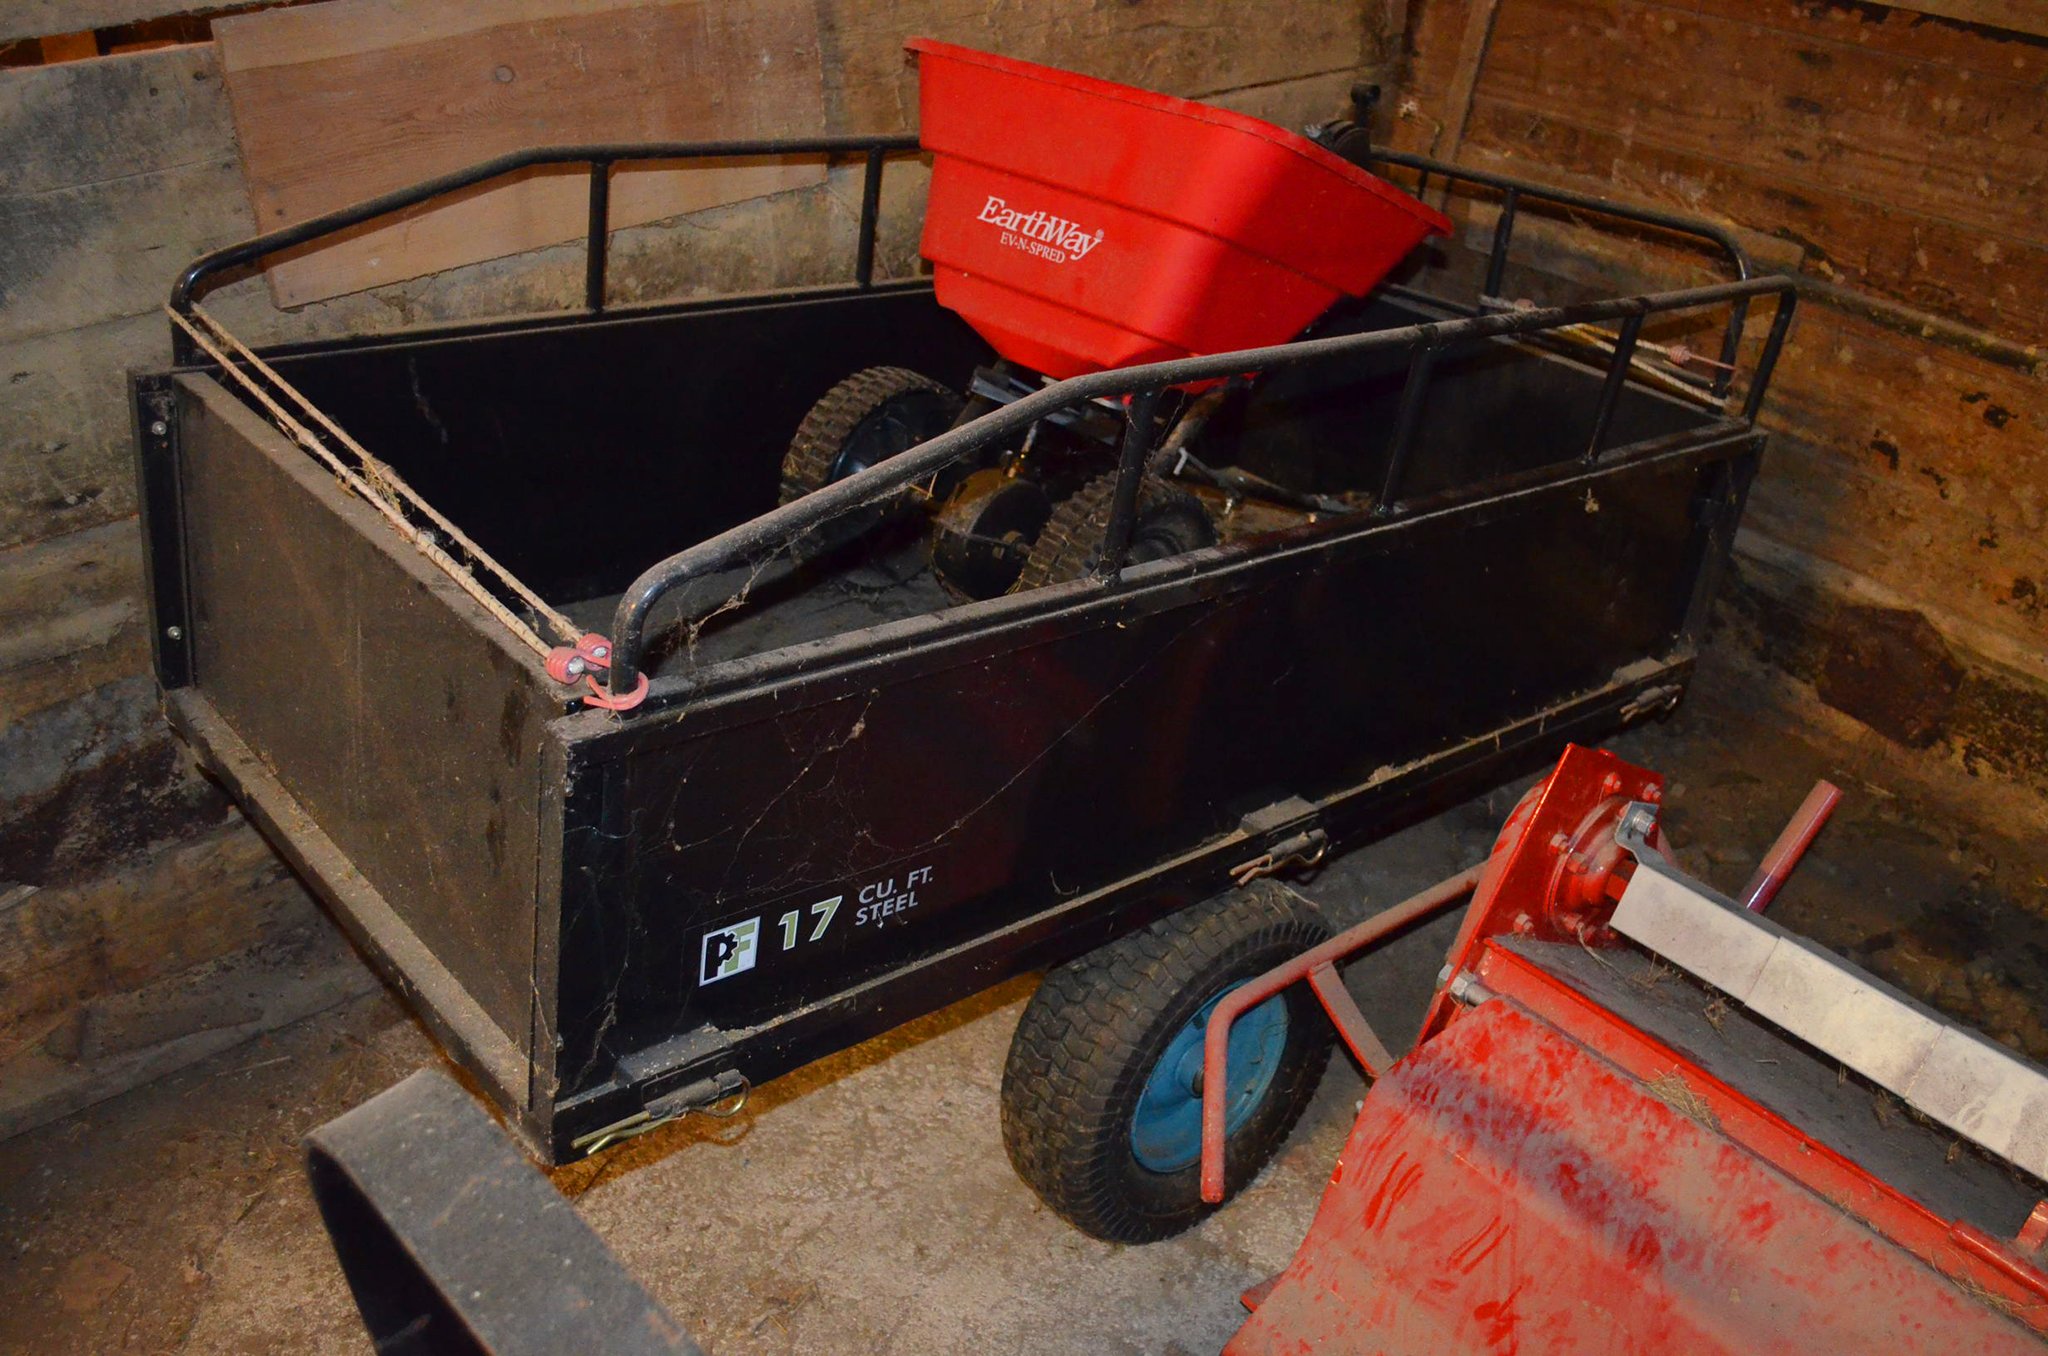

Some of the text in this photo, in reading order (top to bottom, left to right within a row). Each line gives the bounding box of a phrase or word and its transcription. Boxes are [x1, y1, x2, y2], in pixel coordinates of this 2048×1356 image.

[977, 195, 1102, 261] EarthWay
[1000, 231, 1066, 264] EV-N-SPRED
[858, 866, 934, 905] CU. FT.
[778, 895, 843, 951] 17
[855, 892, 918, 926] STEEL
